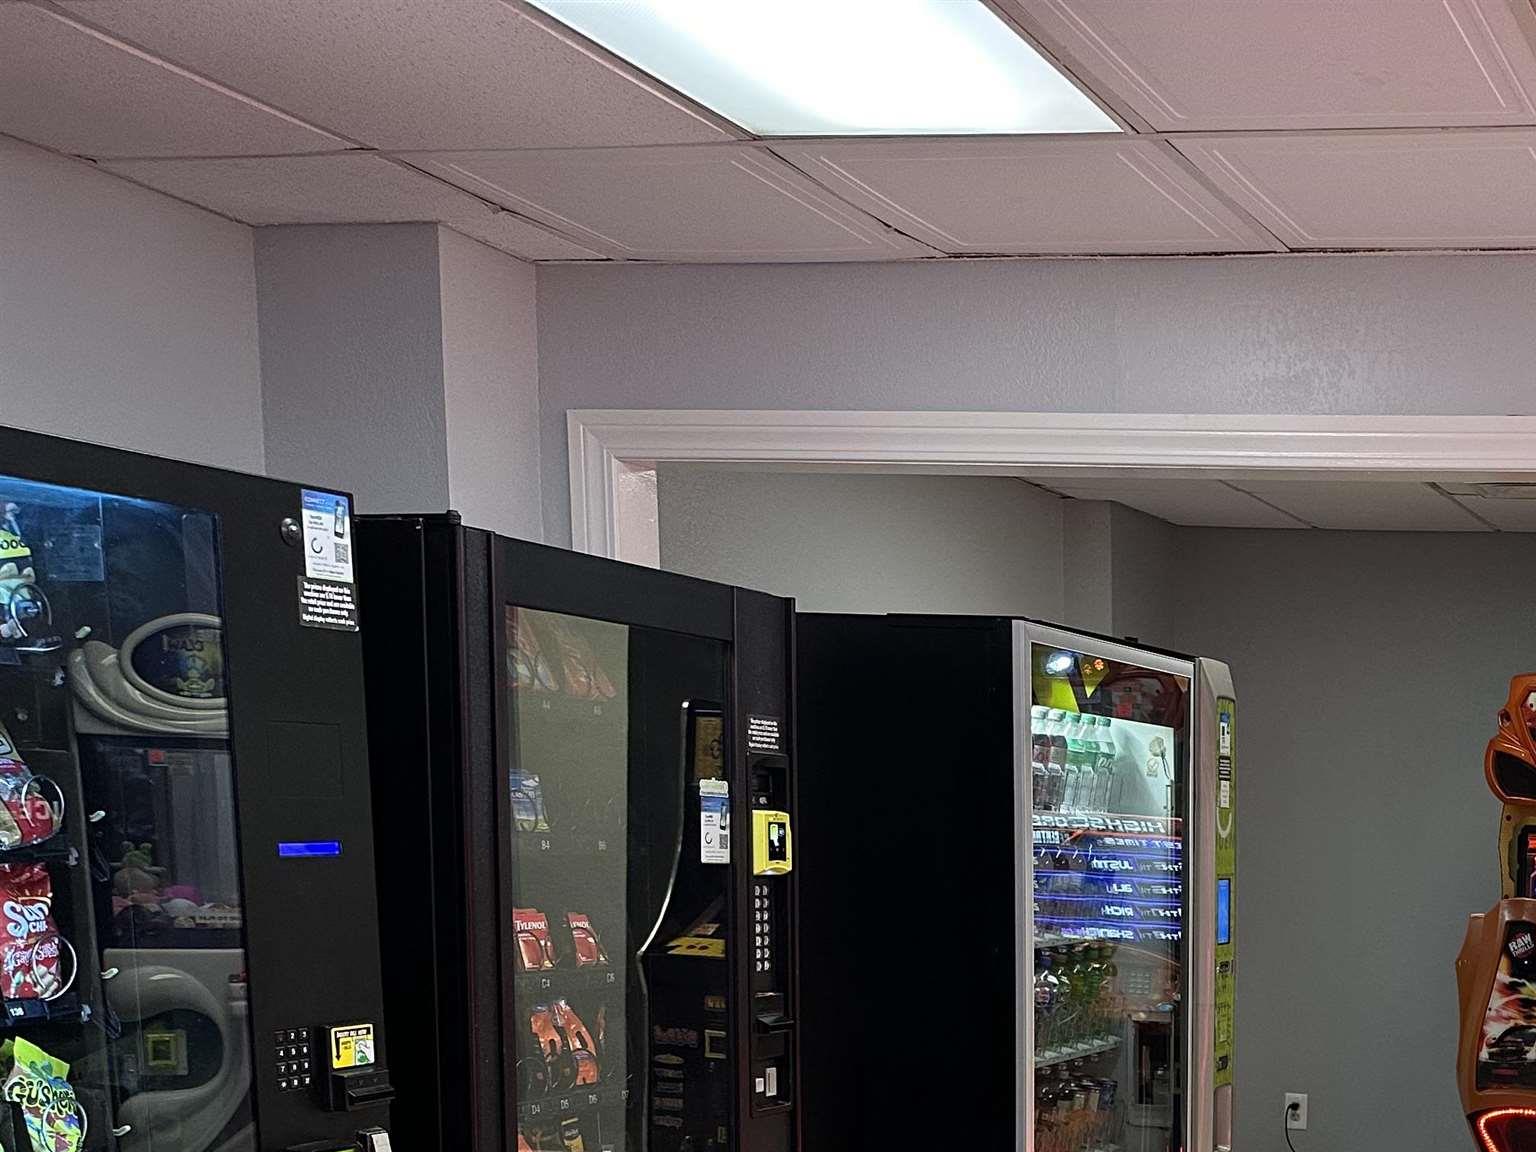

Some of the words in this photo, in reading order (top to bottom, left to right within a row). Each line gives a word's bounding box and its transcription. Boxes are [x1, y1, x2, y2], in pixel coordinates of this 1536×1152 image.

[3, 900, 49, 938] Sun
[515, 920, 546, 931] TYLENOL
[1509, 933, 1532, 952] RAW
